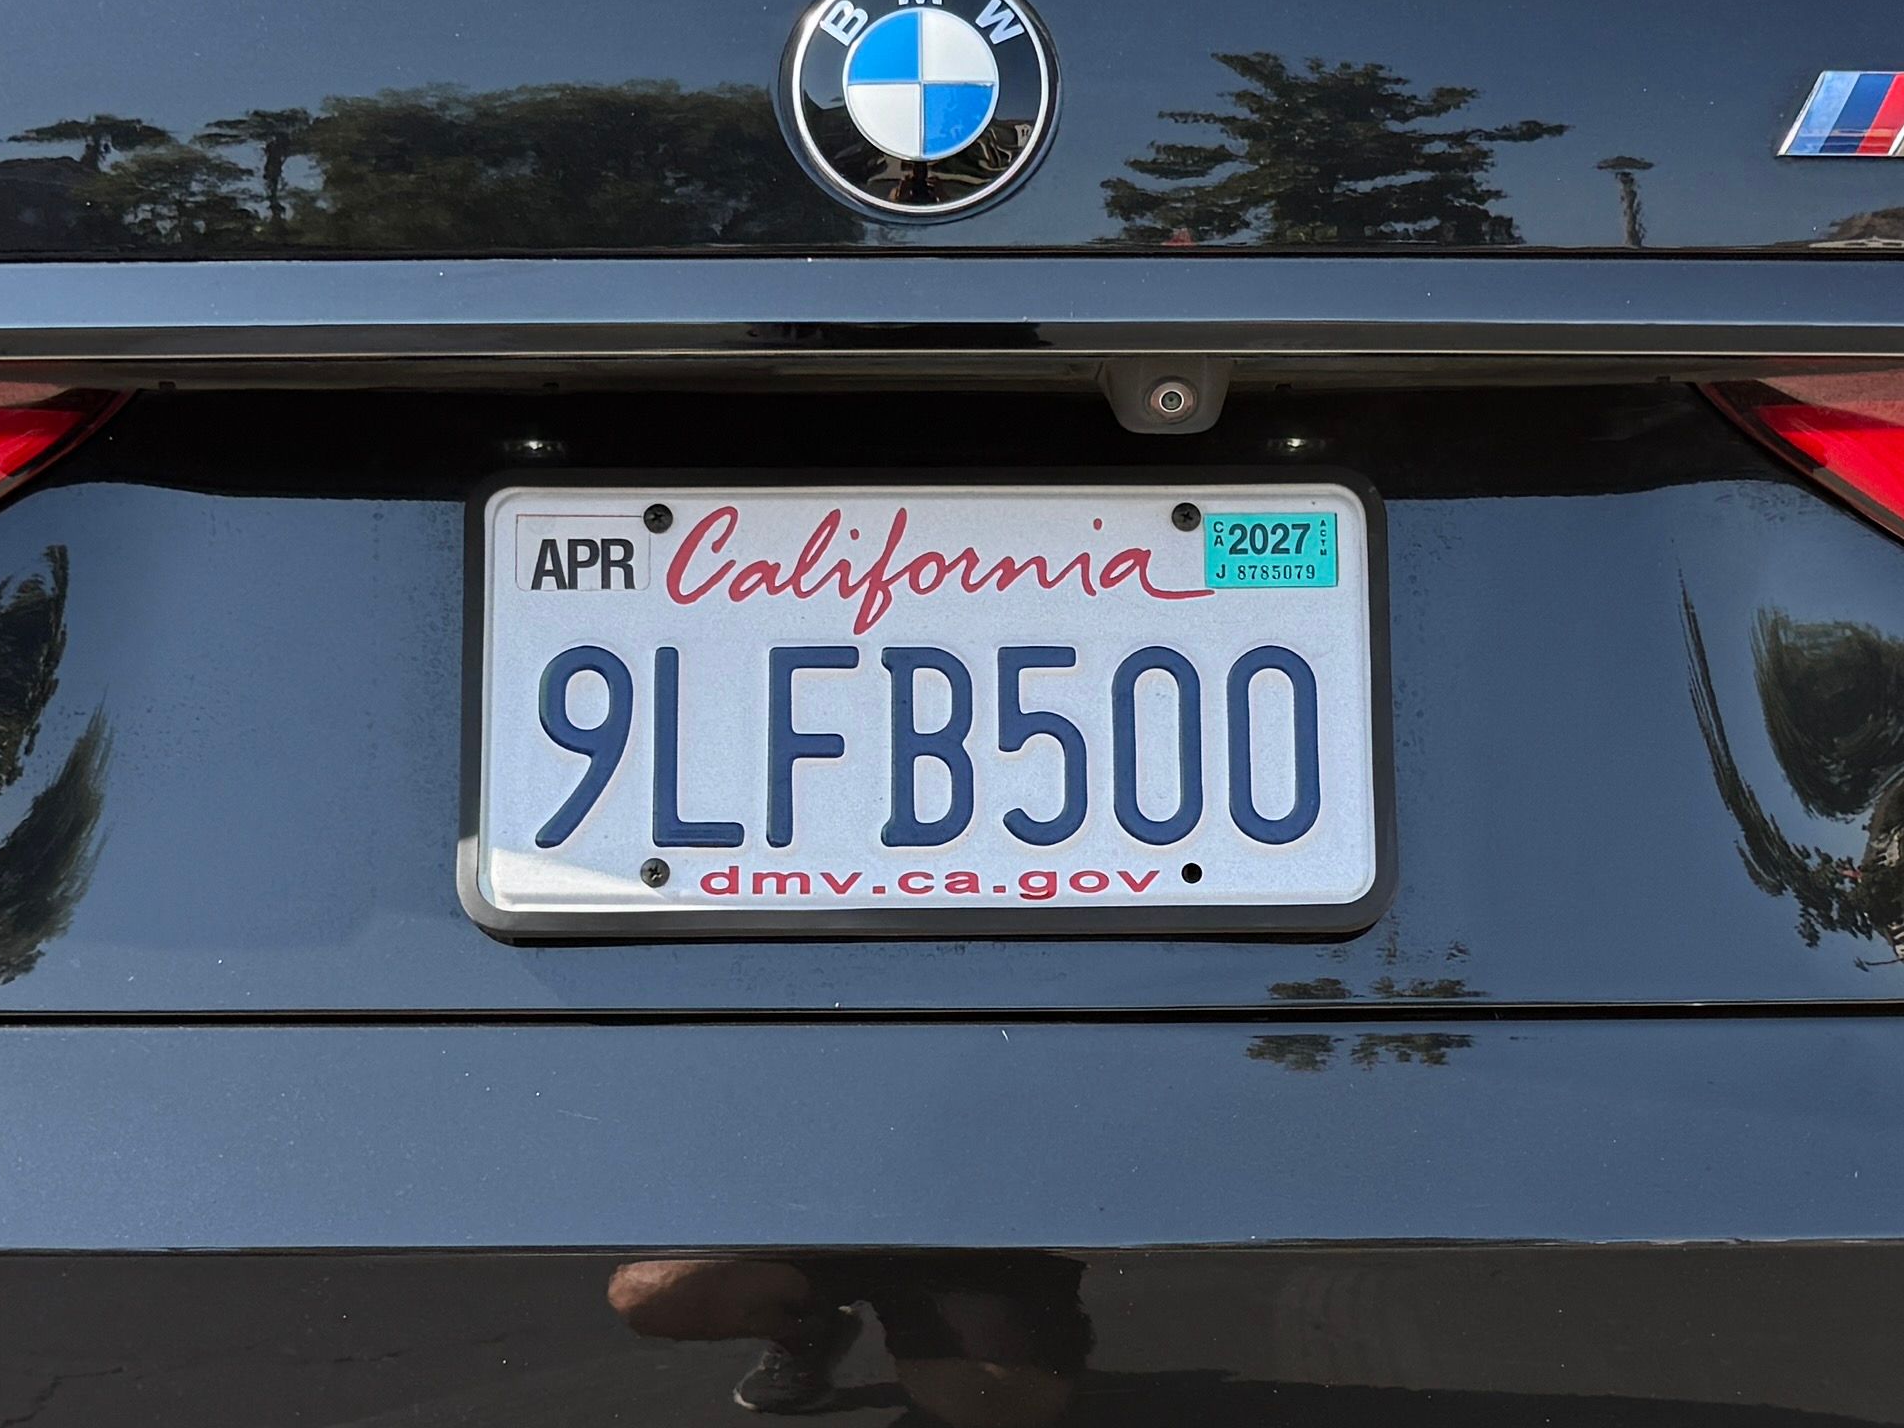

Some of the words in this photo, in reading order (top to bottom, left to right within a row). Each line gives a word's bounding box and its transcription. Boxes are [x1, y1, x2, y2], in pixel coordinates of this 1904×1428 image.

[1228, 522, 1312, 555] 2027
[531, 536, 636, 591] APR
[666, 504, 1215, 635] California
[1215, 564, 1226, 579] J
[1237, 564, 1316, 581] 8785079
[534, 644, 1322, 848] 9LFB500
[699, 862, 1161, 901] dmv.ca.gov
